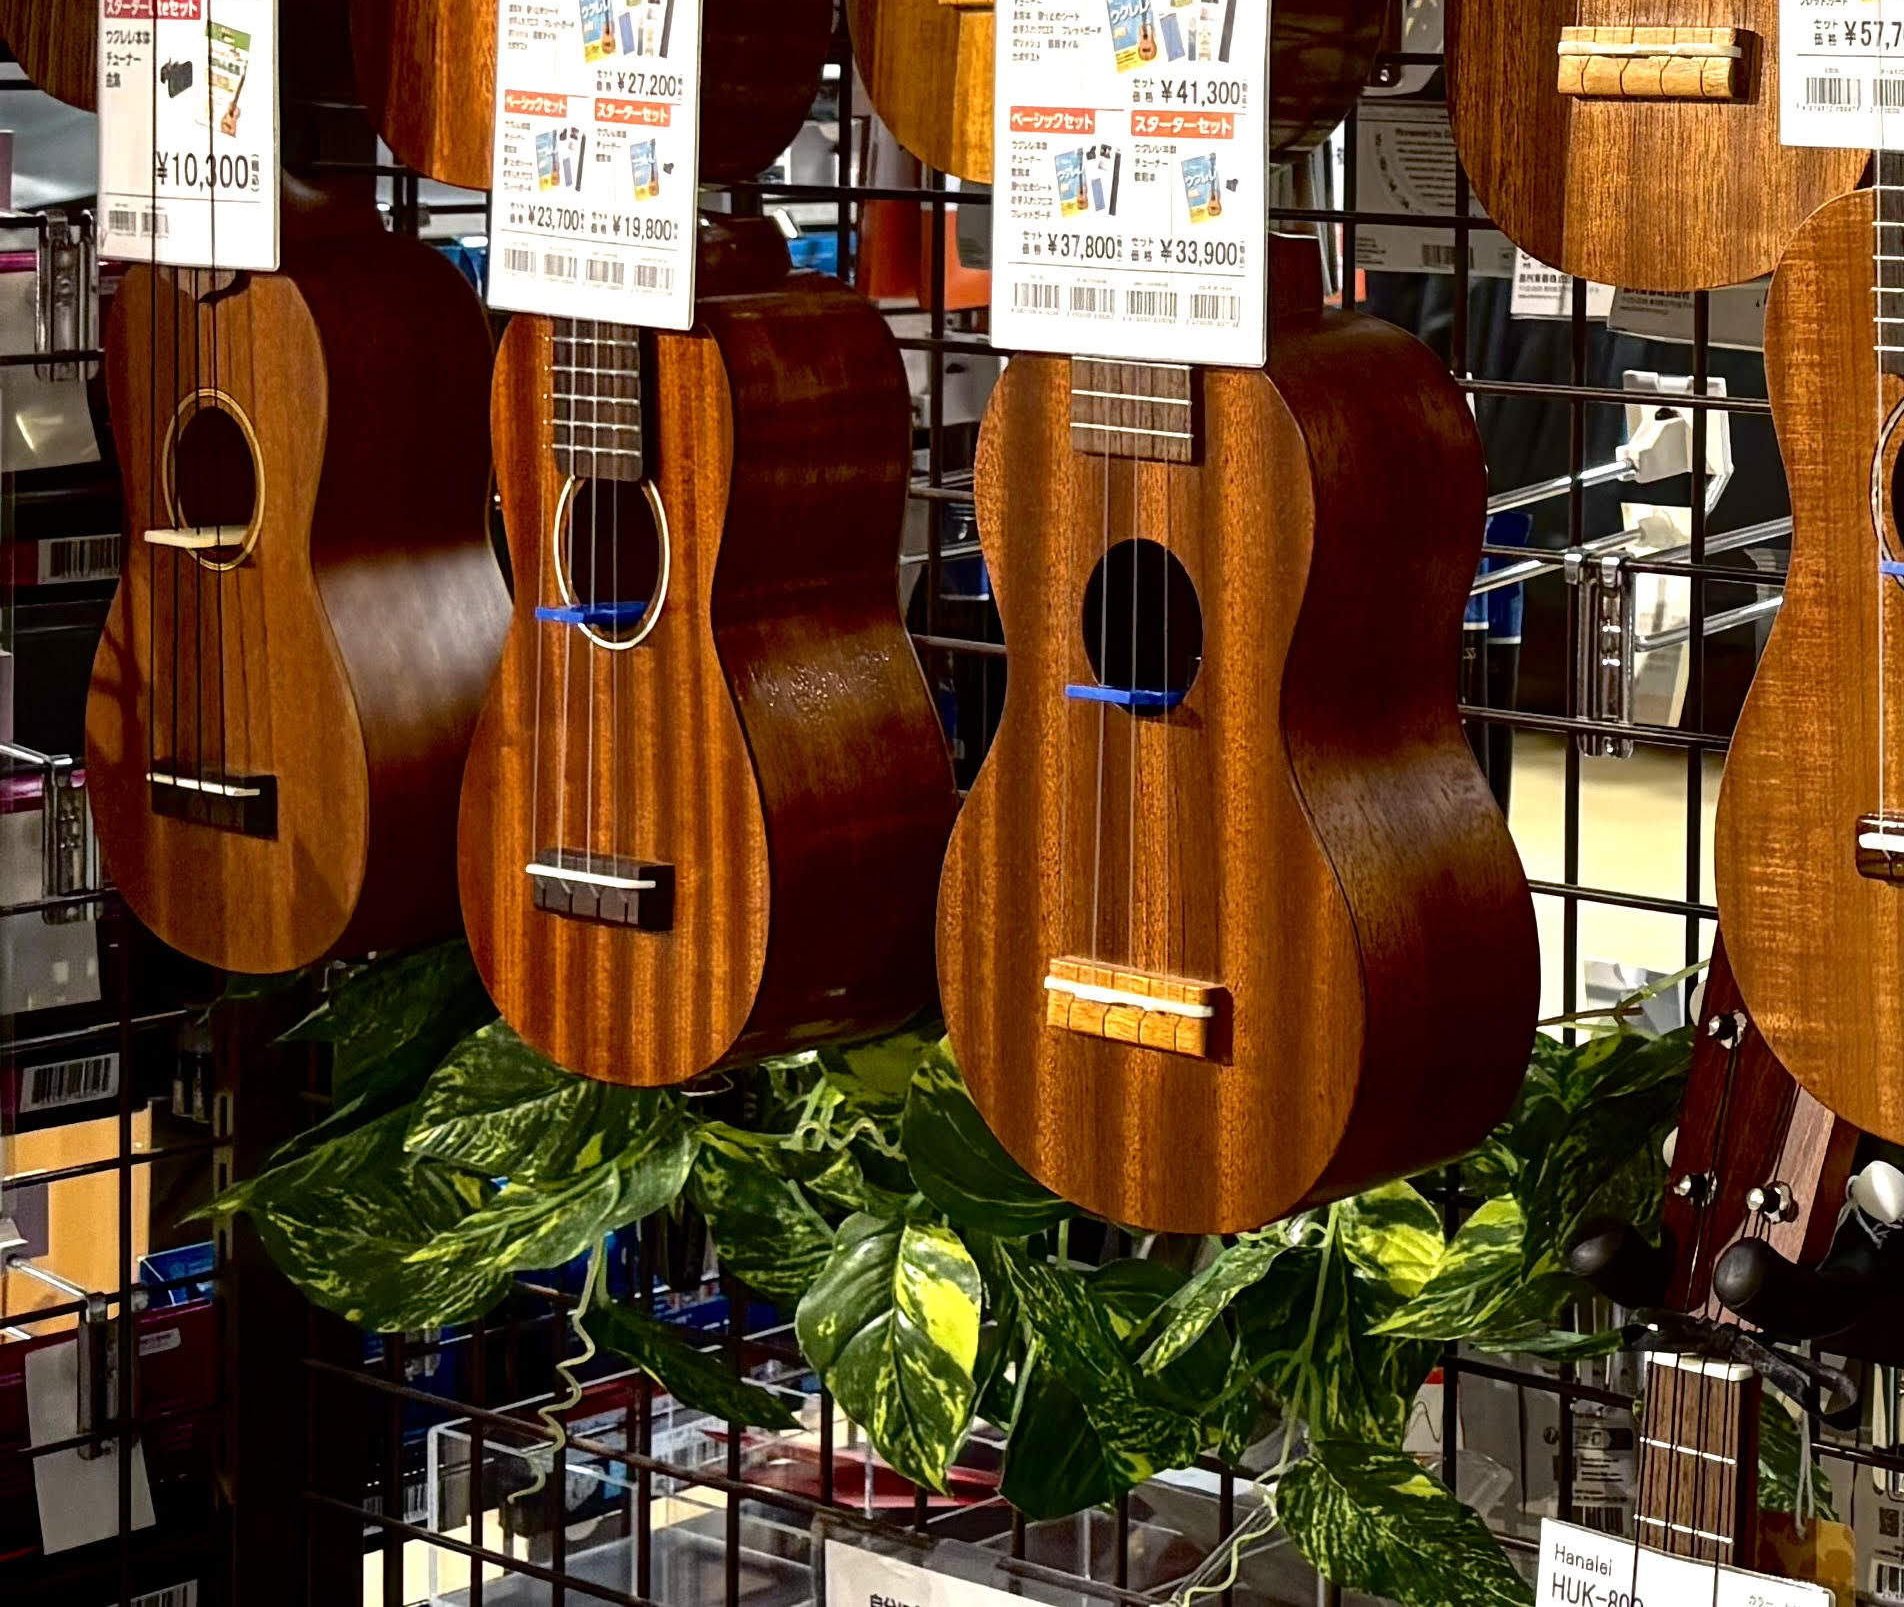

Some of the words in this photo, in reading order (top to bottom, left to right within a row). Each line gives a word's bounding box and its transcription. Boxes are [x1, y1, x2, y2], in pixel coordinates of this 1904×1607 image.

[617, 70, 676, 97] ¥27,200
[1160, 79, 1241, 109] ¥41,300
[596, 102, 669, 124] スターターセット
[1010, 110, 1094, 132] ベーシックセット
[1134, 114, 1232, 137] スターターセット
[156, 151, 250, 190] ¥10,300
[527, 205, 578, 231] ¥23,700
[613, 215, 673, 242] ¥19,800
[1047, 232, 1116, 262] ¥37,800
[1159, 236, 1239, 268] ¥33,900
[1554, 1543, 1612, 1576] Hanalei
